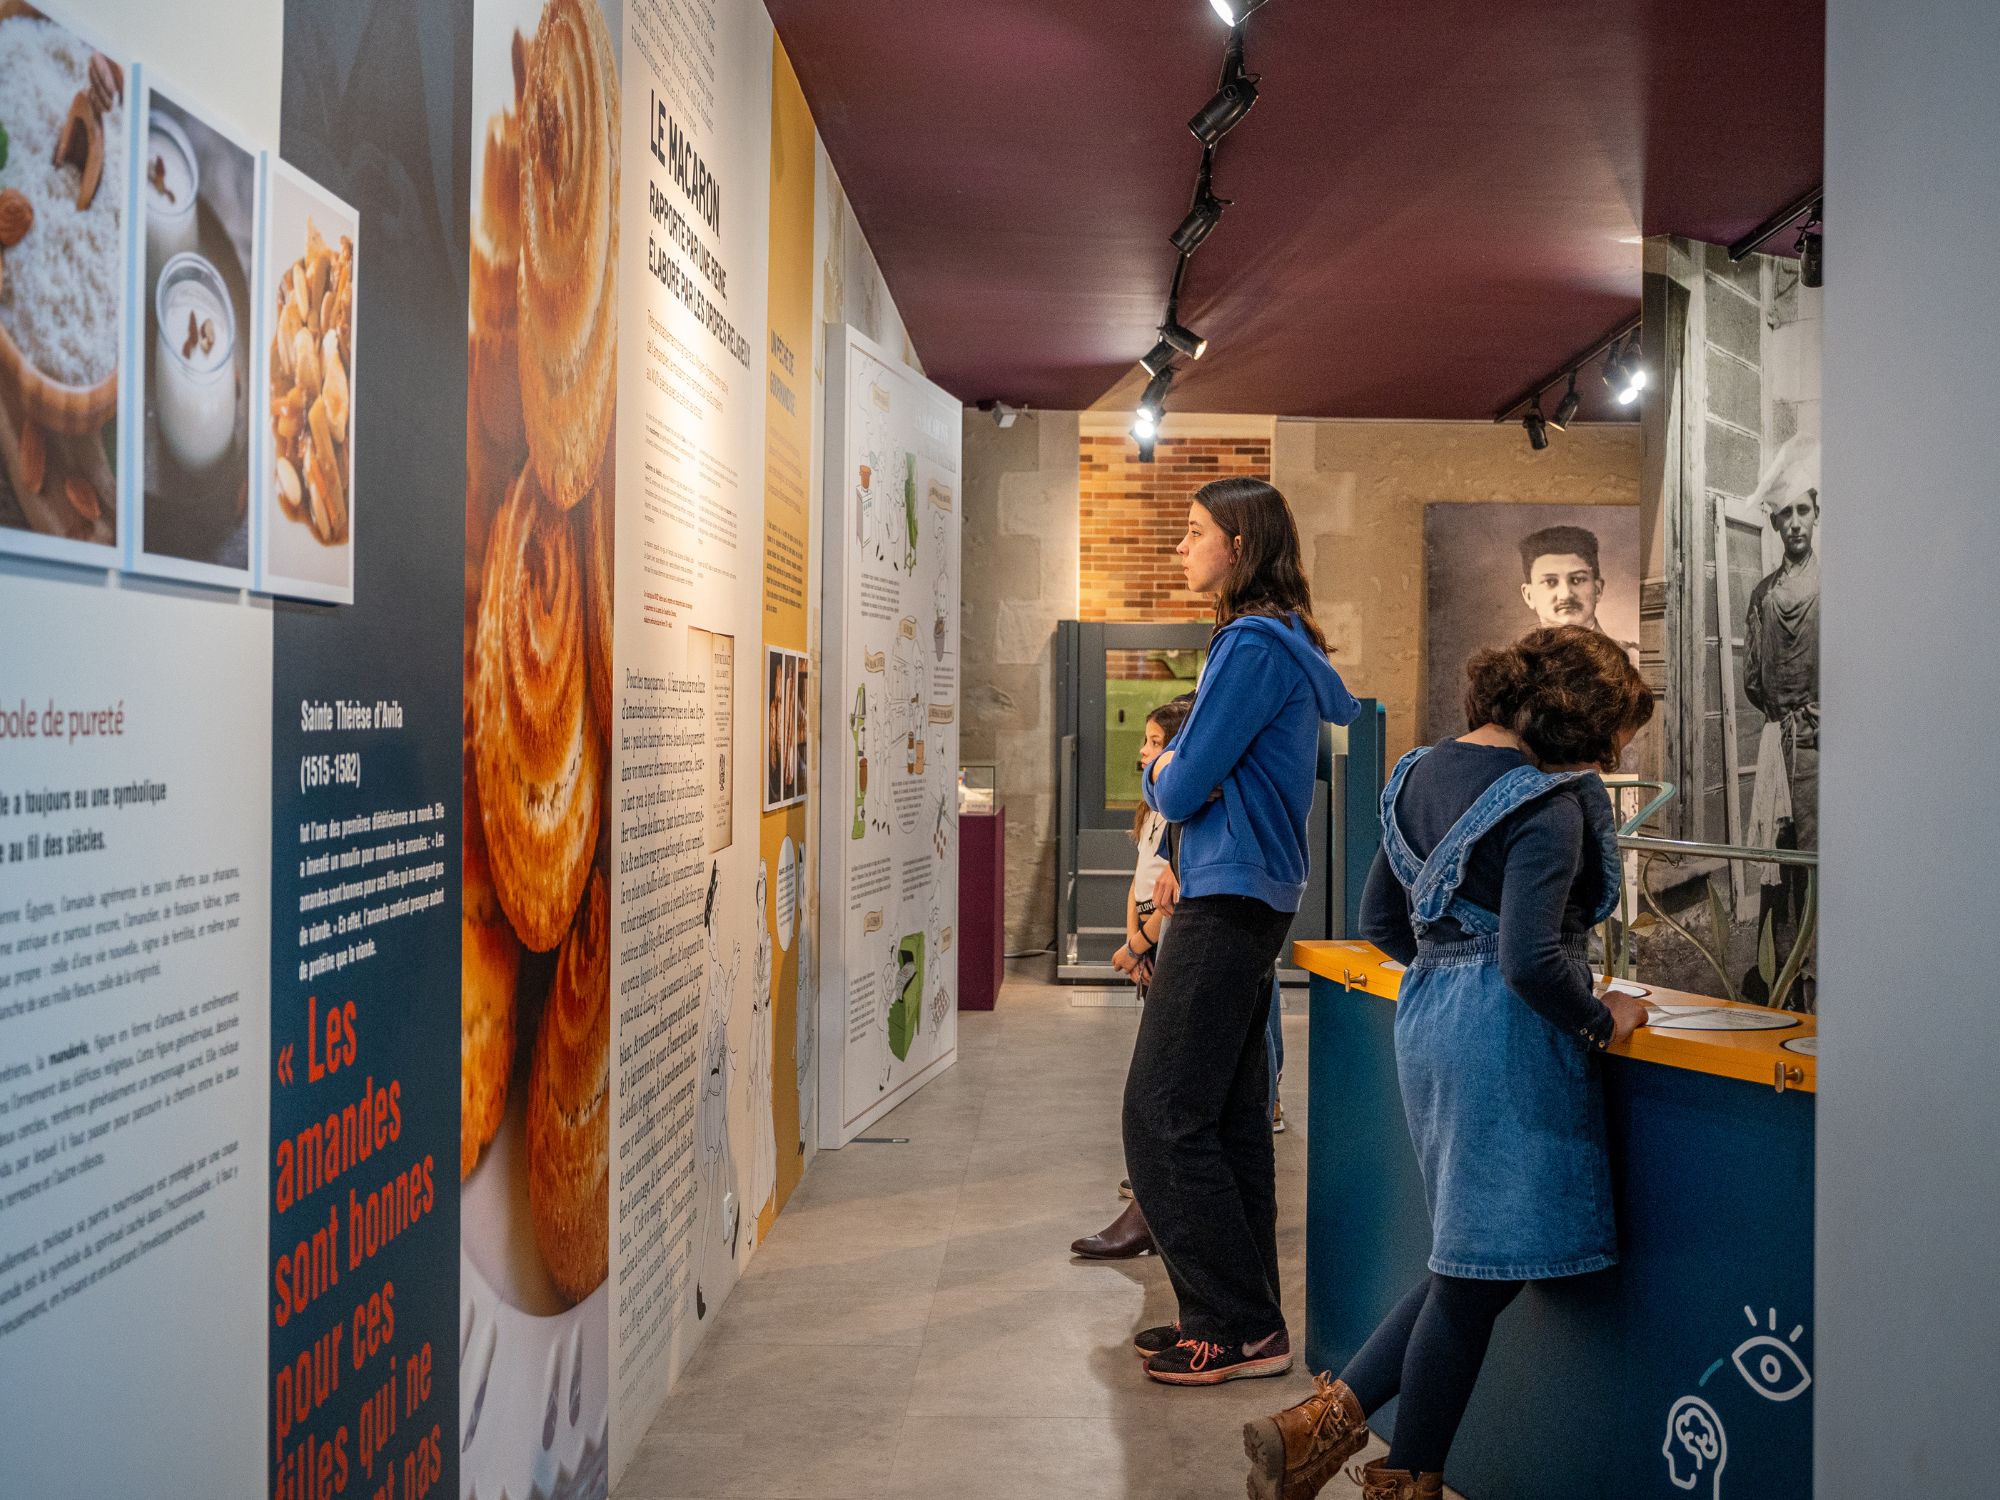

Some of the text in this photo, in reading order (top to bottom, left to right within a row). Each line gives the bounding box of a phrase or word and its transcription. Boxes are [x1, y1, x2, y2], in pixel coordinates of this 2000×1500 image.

[650, 89, 720, 245] LE MACARON,
[650, 180, 686, 252] RAPPORTÉ
[686, 230, 698, 269] PAR
[699, 241, 710, 283] UNE
[649, 230, 680, 299] ÉLABORÉ
[681, 273, 693, 311] PAR
[694, 285, 705, 326] LES
[706, 301, 726, 349] ORDRES
[42, 698, 64, 736] de
[69, 700, 124, 744] pureté
[301, 699, 404, 732] Sainte Thérèse d'Avila
[13, 780, 167, 816] a toujours eu une symbolique
[311, 821, 328, 840] l'une
[329, 819, 340, 837] des
[342, 815, 371, 840] premières
[409, 811, 416, 824] au
[417, 804, 434, 823] monde.
[436, 802, 444, 820] Elle
[9, 830, 105, 862] au fil des siècles.
[300, 831, 444, 877] a inventé un moulin pour moudre les amandes Les
[300, 861, 444, 912] amandes sont bonnes pour ces filles qui ne mangent pas
[300, 886, 444, 946] de viande. En effet, l'amande contient presque autant
[299, 940, 376, 983] de protéine que la viande.
[277, 996, 356, 1088] « Les
[276, 1076, 400, 1214] amandes
[275, 1204, 338, 1328] sont
[350, 1154, 434, 1272] bonnes
[276, 1280, 394, 1464] pour ces
[360, 1355, 396, 1480] qui
[406, 1342, 432, 1418] ne
